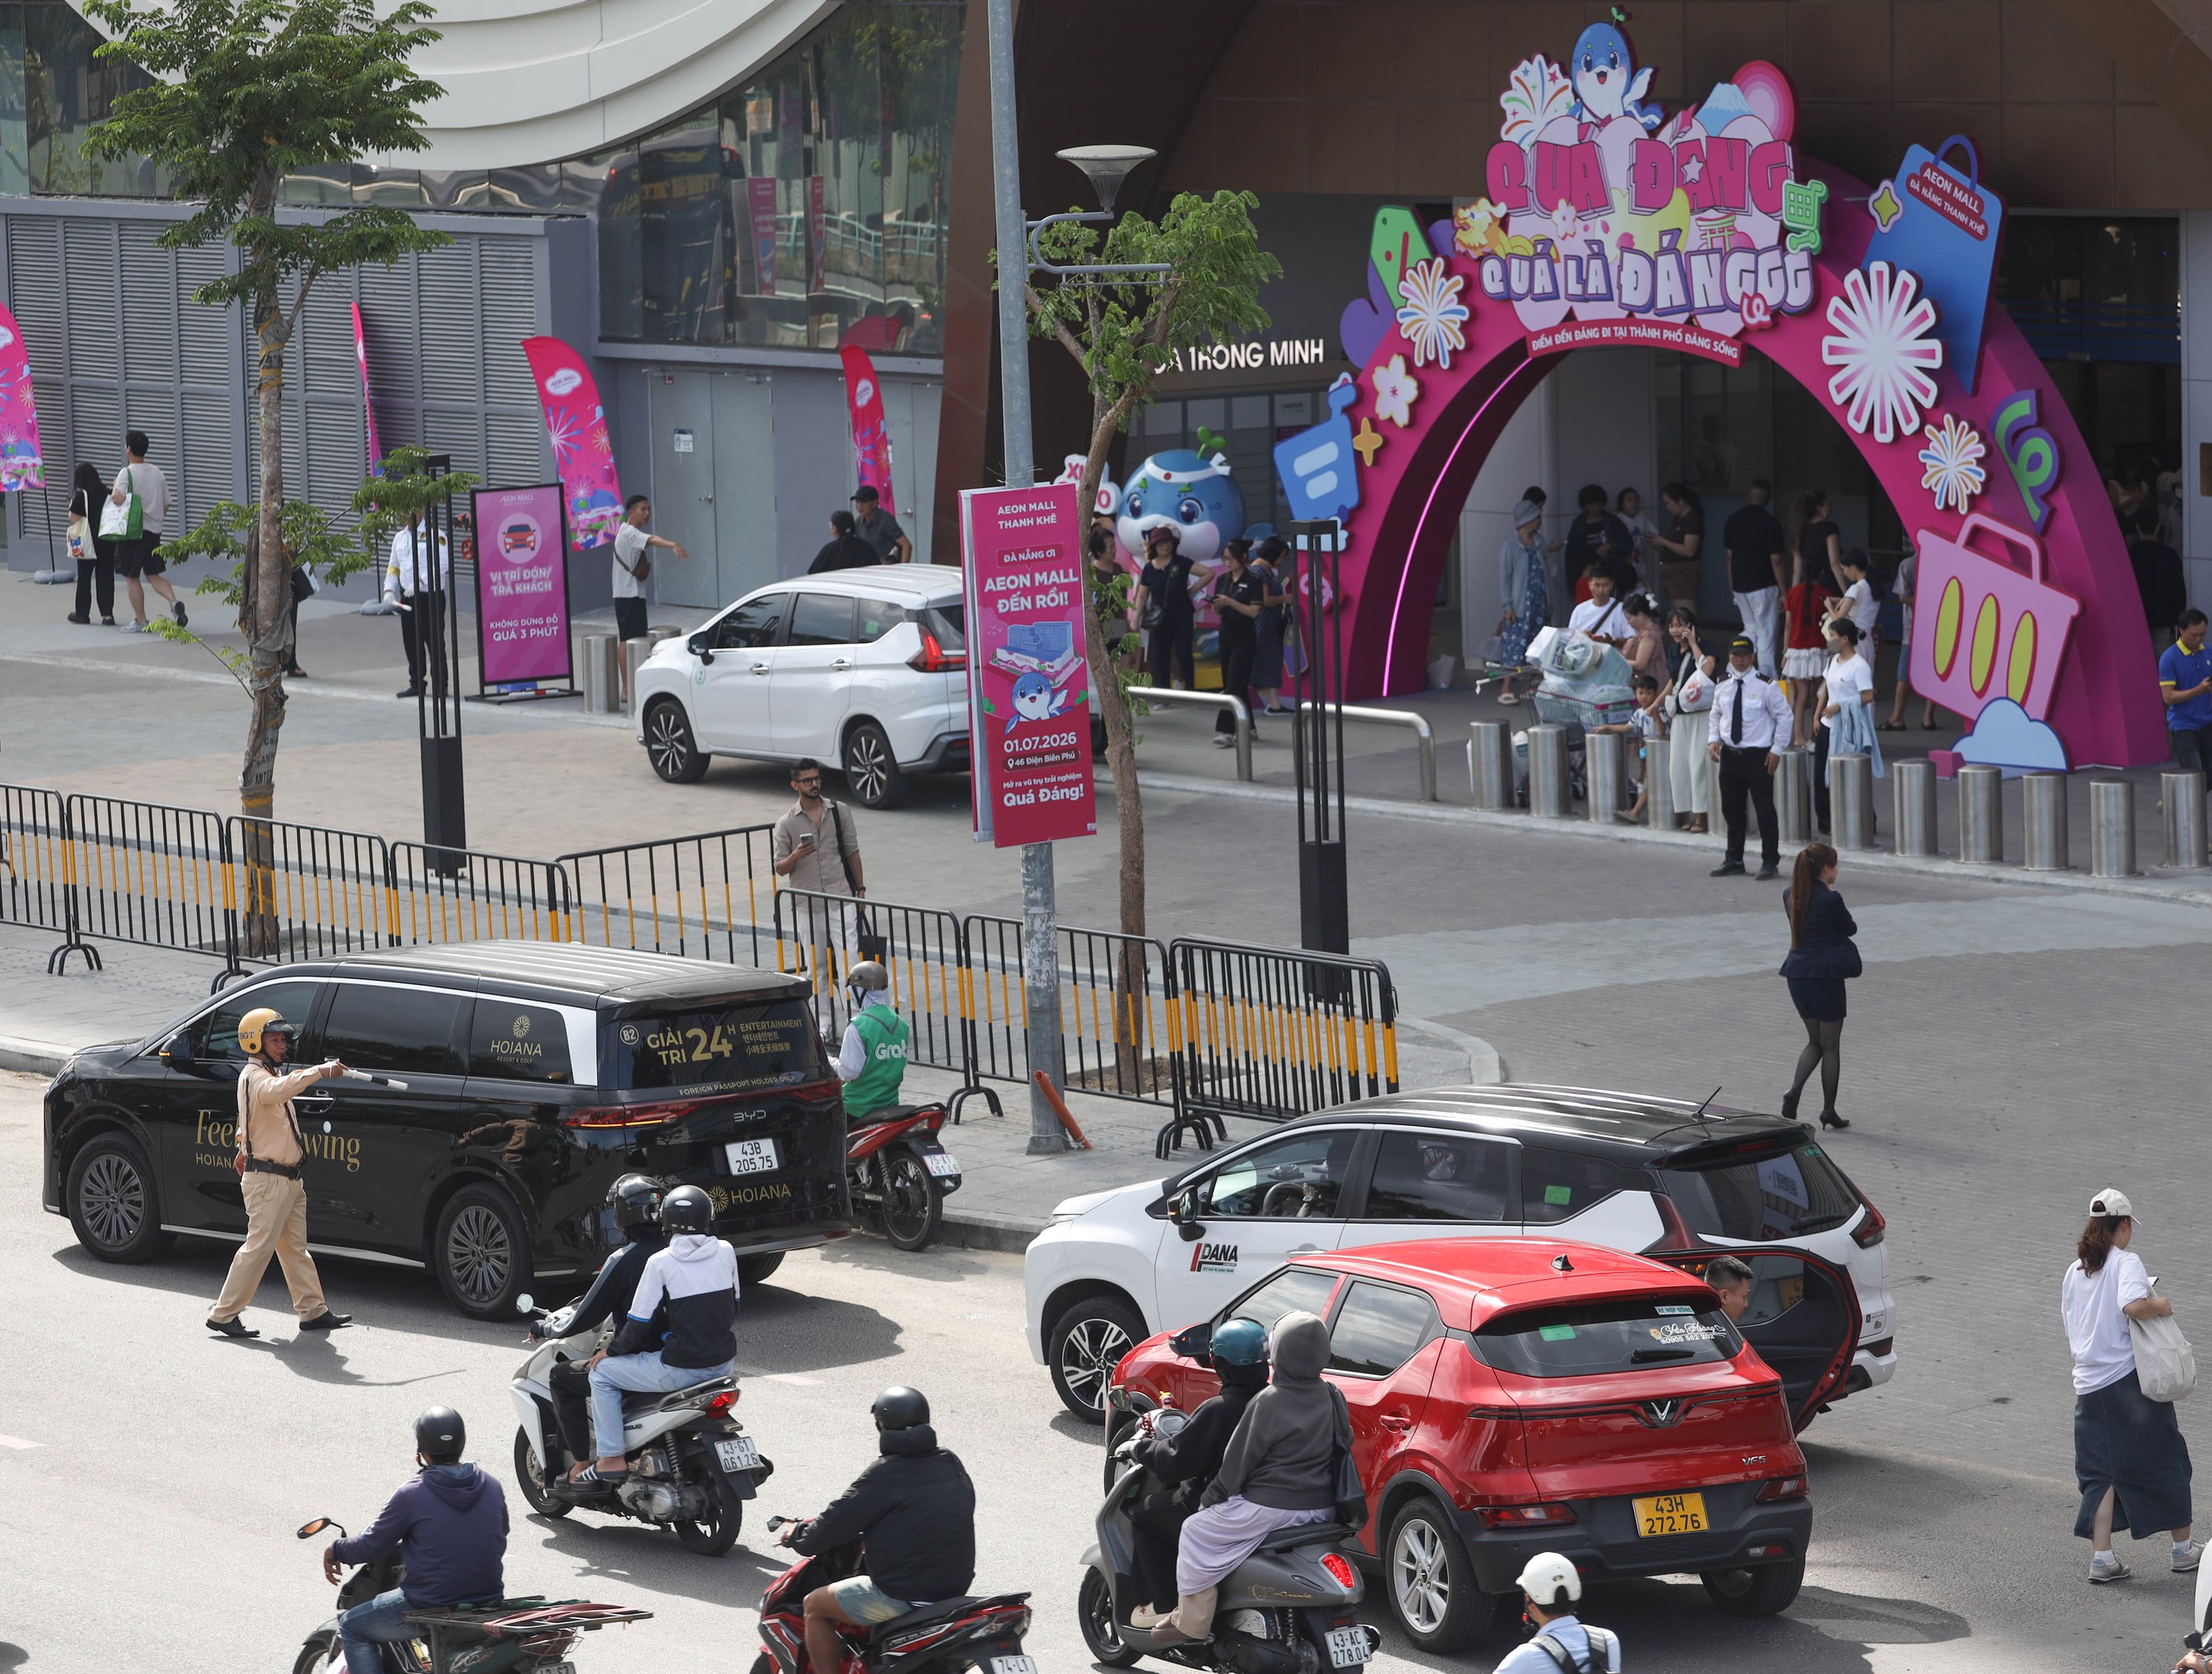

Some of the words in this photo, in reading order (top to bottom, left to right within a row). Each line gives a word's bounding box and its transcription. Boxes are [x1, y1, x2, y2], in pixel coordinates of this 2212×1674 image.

[1486, 123, 1611, 218] QUÁ
[1923, 167, 1952, 194] AEON
[1953, 187, 1979, 213] MALL
[1910, 179, 1920, 192] ĐÀ
[1943, 201, 1968, 225] THANH
[1969, 219, 1985, 236] KHÊ
[1480, 239, 1560, 301] QUÁ
[1564, 239, 1613, 302] LÀ
[1532, 334, 1553, 351] ĐIỂM
[1554, 328, 1573, 345] ĐẾN
[1574, 326, 1599, 341] ĐÁNG
[1601, 328, 1611, 337] ĐI
[1613, 327, 1627, 340] TẠI
[1629, 324, 1661, 339] THÀNH
[1662, 328, 1682, 342] PHỐ
[1685, 333, 1711, 350] ĐÁNG
[1713, 340, 1738, 359] SỐNG
[1270, 338, 1324, 366] MINH
[997, 504, 1027, 516] AEON
[1029, 500, 1057, 512] MALL
[998, 517, 1034, 530] THANH
[1037, 513, 1057, 525] KHÊ
[1003, 550, 1017, 563] ĐÀ
[504, 567, 520, 582] TRÍ
[984, 574, 1031, 593] AEON
[1035, 569, 1078, 587] MALL
[516, 579, 552, 594] KHÁCH
[997, 591, 1032, 613] ĐẾN
[1037, 587, 1069, 608] RỒI!
[490, 616, 518, 629] KHÔNG
[520, 615, 543, 627] DỪNG
[493, 627, 518, 641] QUÁ
[520, 629, 526, 639] 3
[530, 625, 559, 638] PHÚT
[1004, 732, 1077, 753] 01.07.2026
[1014, 757, 1025, 767] 46
[1027, 754, 1043, 766] Điện
[1045, 753, 1060, 763] Biên
[1061, 750, 1075, 761] Phủ
[1003, 780, 1014, 788] Mở
[1023, 777, 1032, 786] vũ
[1033, 778, 1043, 787] trụ
[1044, 775, 1056, 784] trải
[1057, 772, 1083, 784] nghiệm
[1003, 788, 1035, 807] Quá
[1039, 783, 1084, 803] Đáng!
[622, 1028, 637, 1041] B2
[740, 1019, 803, 1032] ENTERTAINMENT
[491, 1040, 543, 1056] HOIANA
[646, 1027, 683, 1049] GIẢI
[685, 1025, 733, 1062] 24
[727, 1024, 736, 1035] H
[679, 1085, 713, 1097] FOREIGN
[714, 1079, 750, 1092] PASSPORT
[752, 1076, 779, 1087] HOLDER
[779, 1074, 796, 1083] ONLY
[734, 1110, 766, 1123] BYD
[741, 1142, 762, 1155] 43B
[735, 1155, 773, 1173] 205.75
[731, 1183, 791, 1205] HOIANA
[1199, 1243, 1238, 1262] DANA
[721, 1440, 750, 1454] 43-G1
[723, 1453, 758, 1469] 061.26
[1656, 1496, 1685, 1513] 43H
[1645, 1513, 1701, 1534] 272.76
[1332, 1630, 1362, 1648] 43-AC
[1333, 1647, 1370, 1665] 278.04
